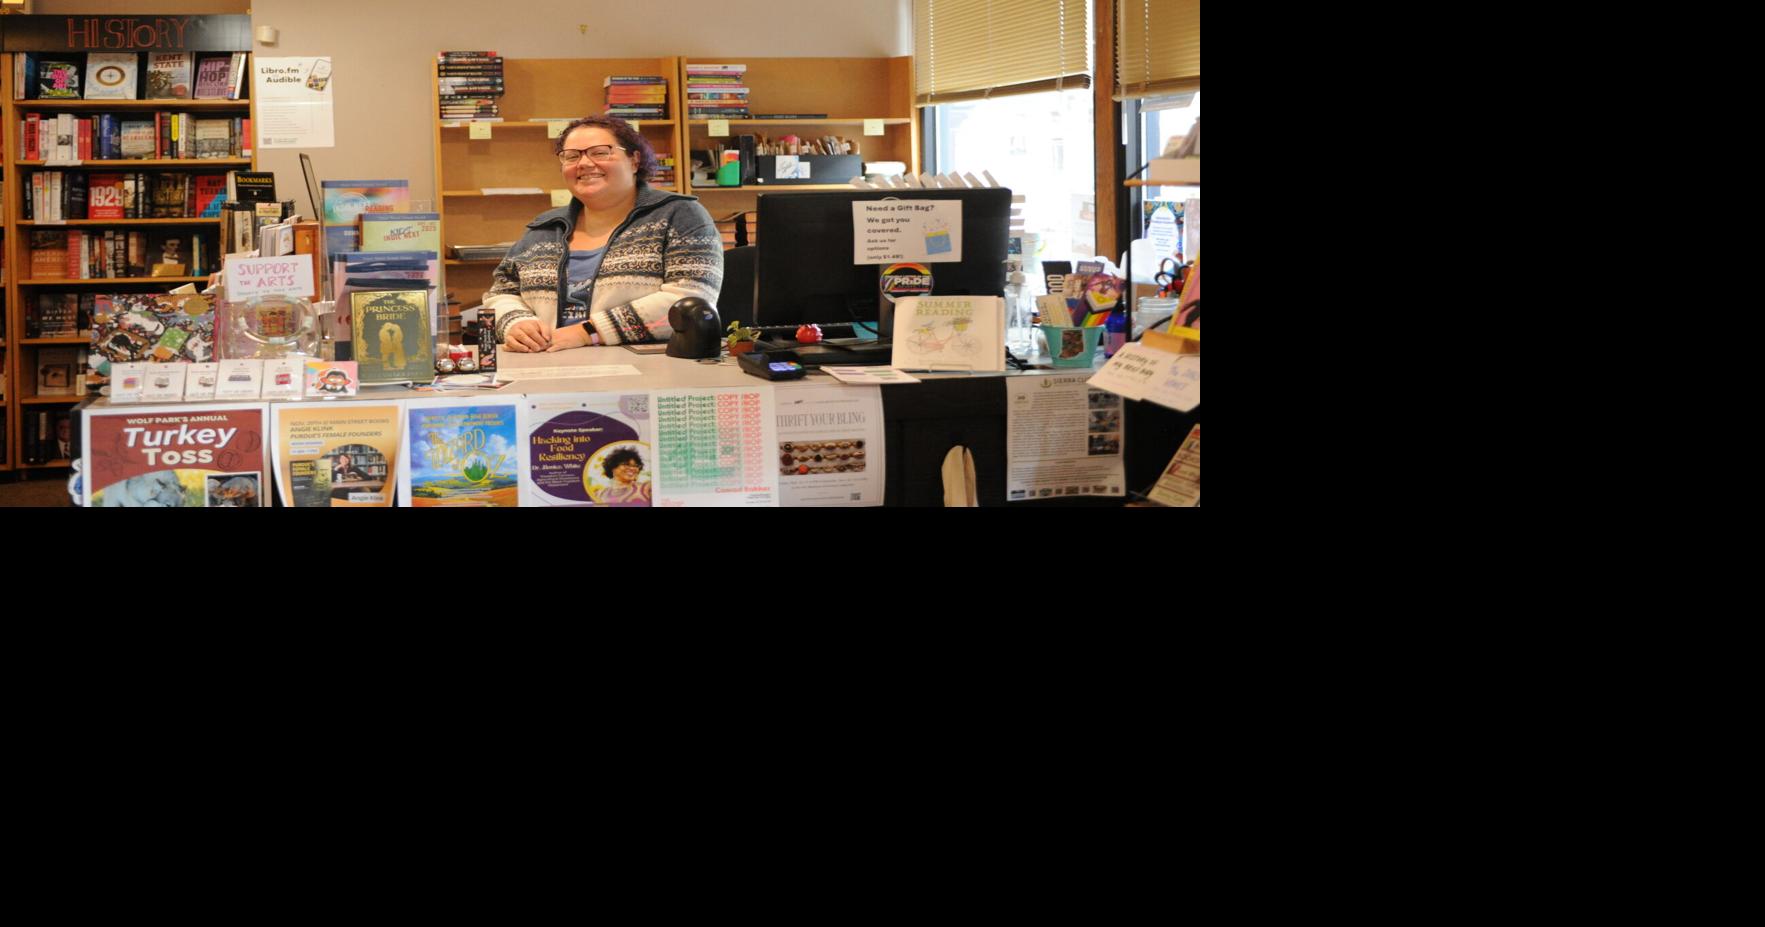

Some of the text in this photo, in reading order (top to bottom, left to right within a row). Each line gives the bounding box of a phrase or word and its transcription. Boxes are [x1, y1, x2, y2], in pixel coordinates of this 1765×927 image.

[155, 54, 184, 62] KENT
[201, 72, 226, 82] HOP
[90, 186, 124, 207] 1929
[238, 262, 298, 276] SUPPORT
[257, 275, 294, 287] ARTS
[366, 305, 416, 313] PRINCESS
[776, 411, 866, 428] THRIFT YOUR BLING
[124, 424, 237, 448] Turkey
[533, 436, 571, 445] Hacking
[539, 453, 586, 462] Resiliency
